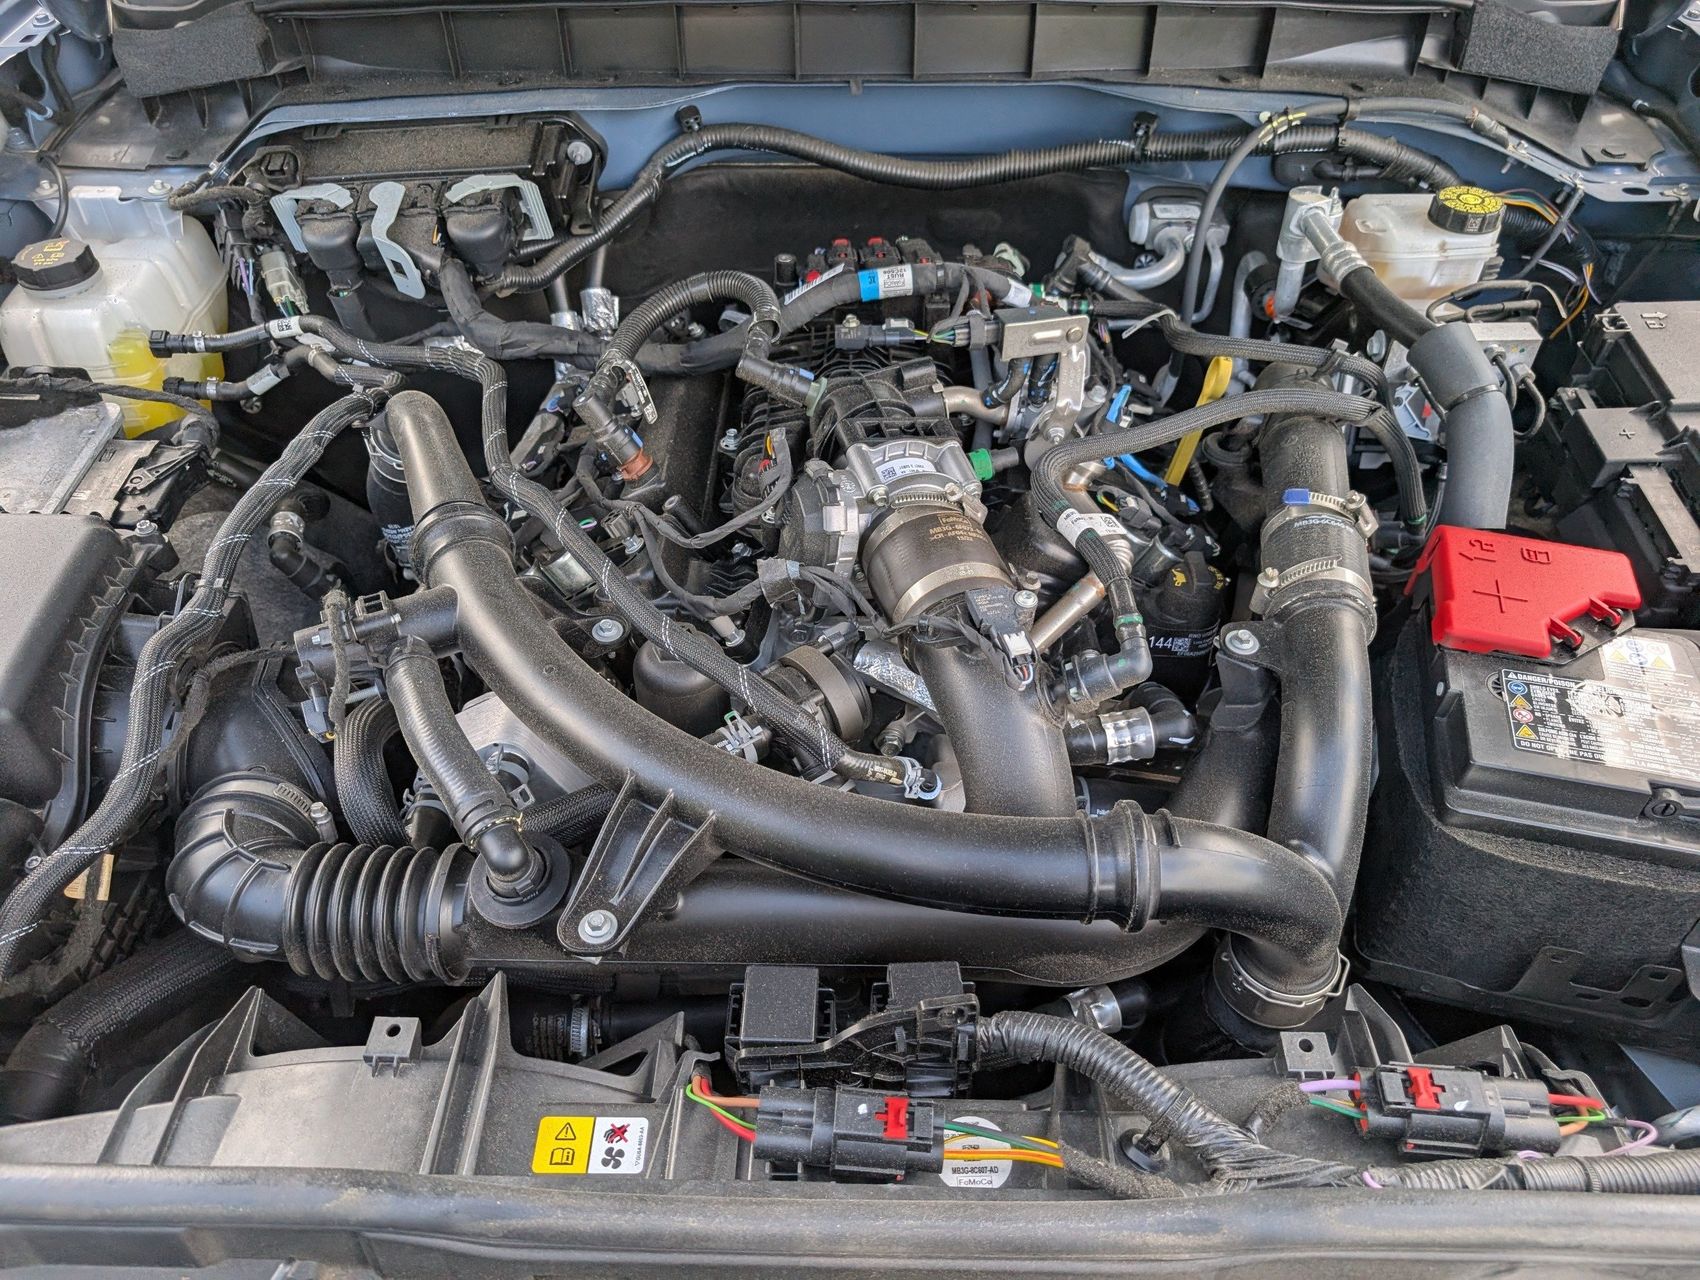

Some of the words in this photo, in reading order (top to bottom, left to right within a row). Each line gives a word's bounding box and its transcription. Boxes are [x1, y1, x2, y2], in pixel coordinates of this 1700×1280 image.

[1149, 635, 1173, 648] 144
[1517, 673, 1576, 688] DANGER/POISON
[958, 1178, 993, 1186] FoMoCo
